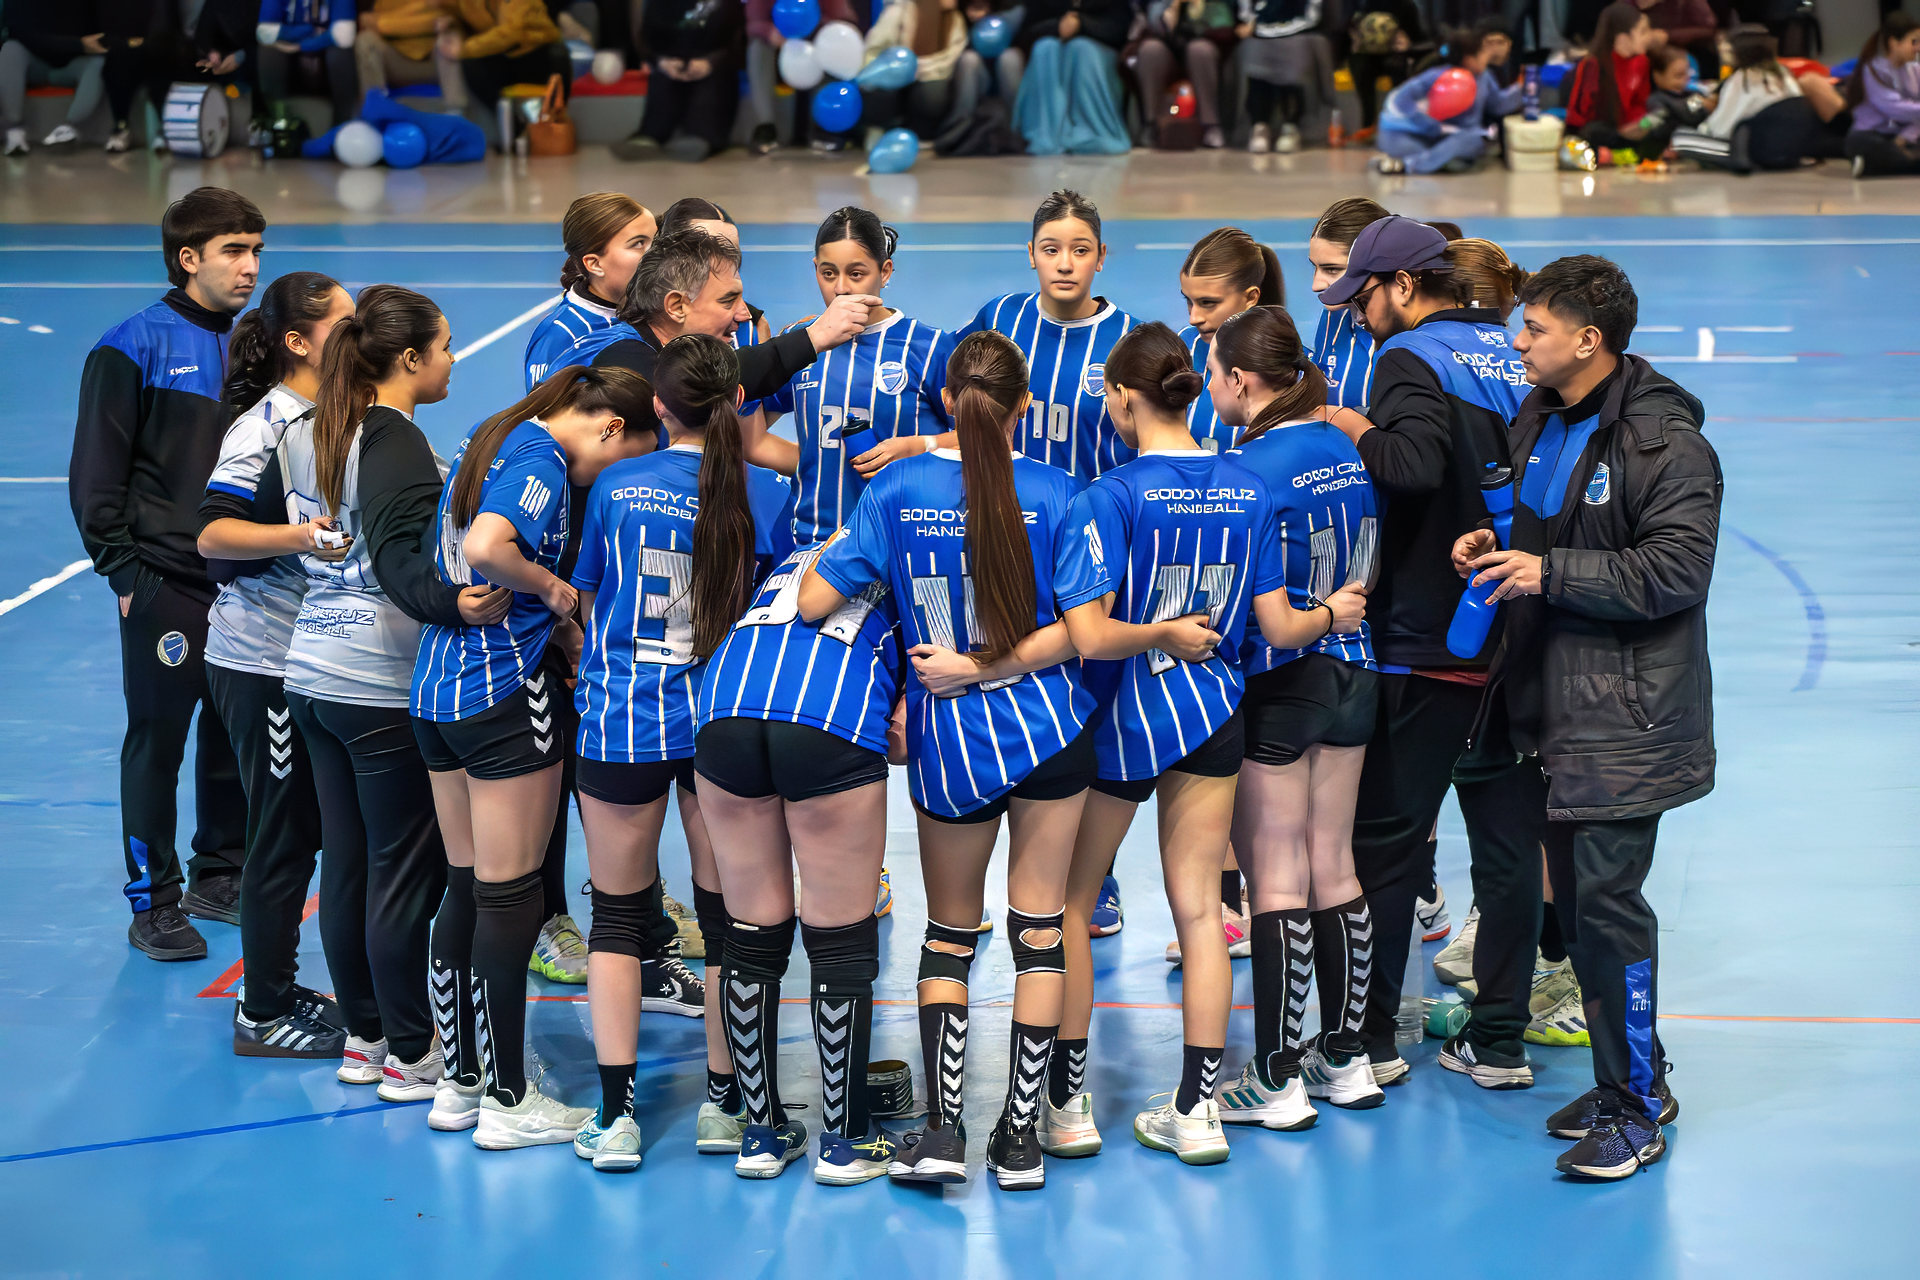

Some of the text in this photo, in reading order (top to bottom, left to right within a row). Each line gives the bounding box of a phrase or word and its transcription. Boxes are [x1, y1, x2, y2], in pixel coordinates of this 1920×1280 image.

[1031, 399, 1069, 442] 10
[1337, 461, 1366, 475] CRU
[611, 486, 683, 504] GODOY
[1144, 488, 1257, 501] GODOY CRUZ
[630, 500, 699, 522] HANDB
[900, 508, 969, 523] GODOY
[1166, 502, 1246, 514] HANDBALL
